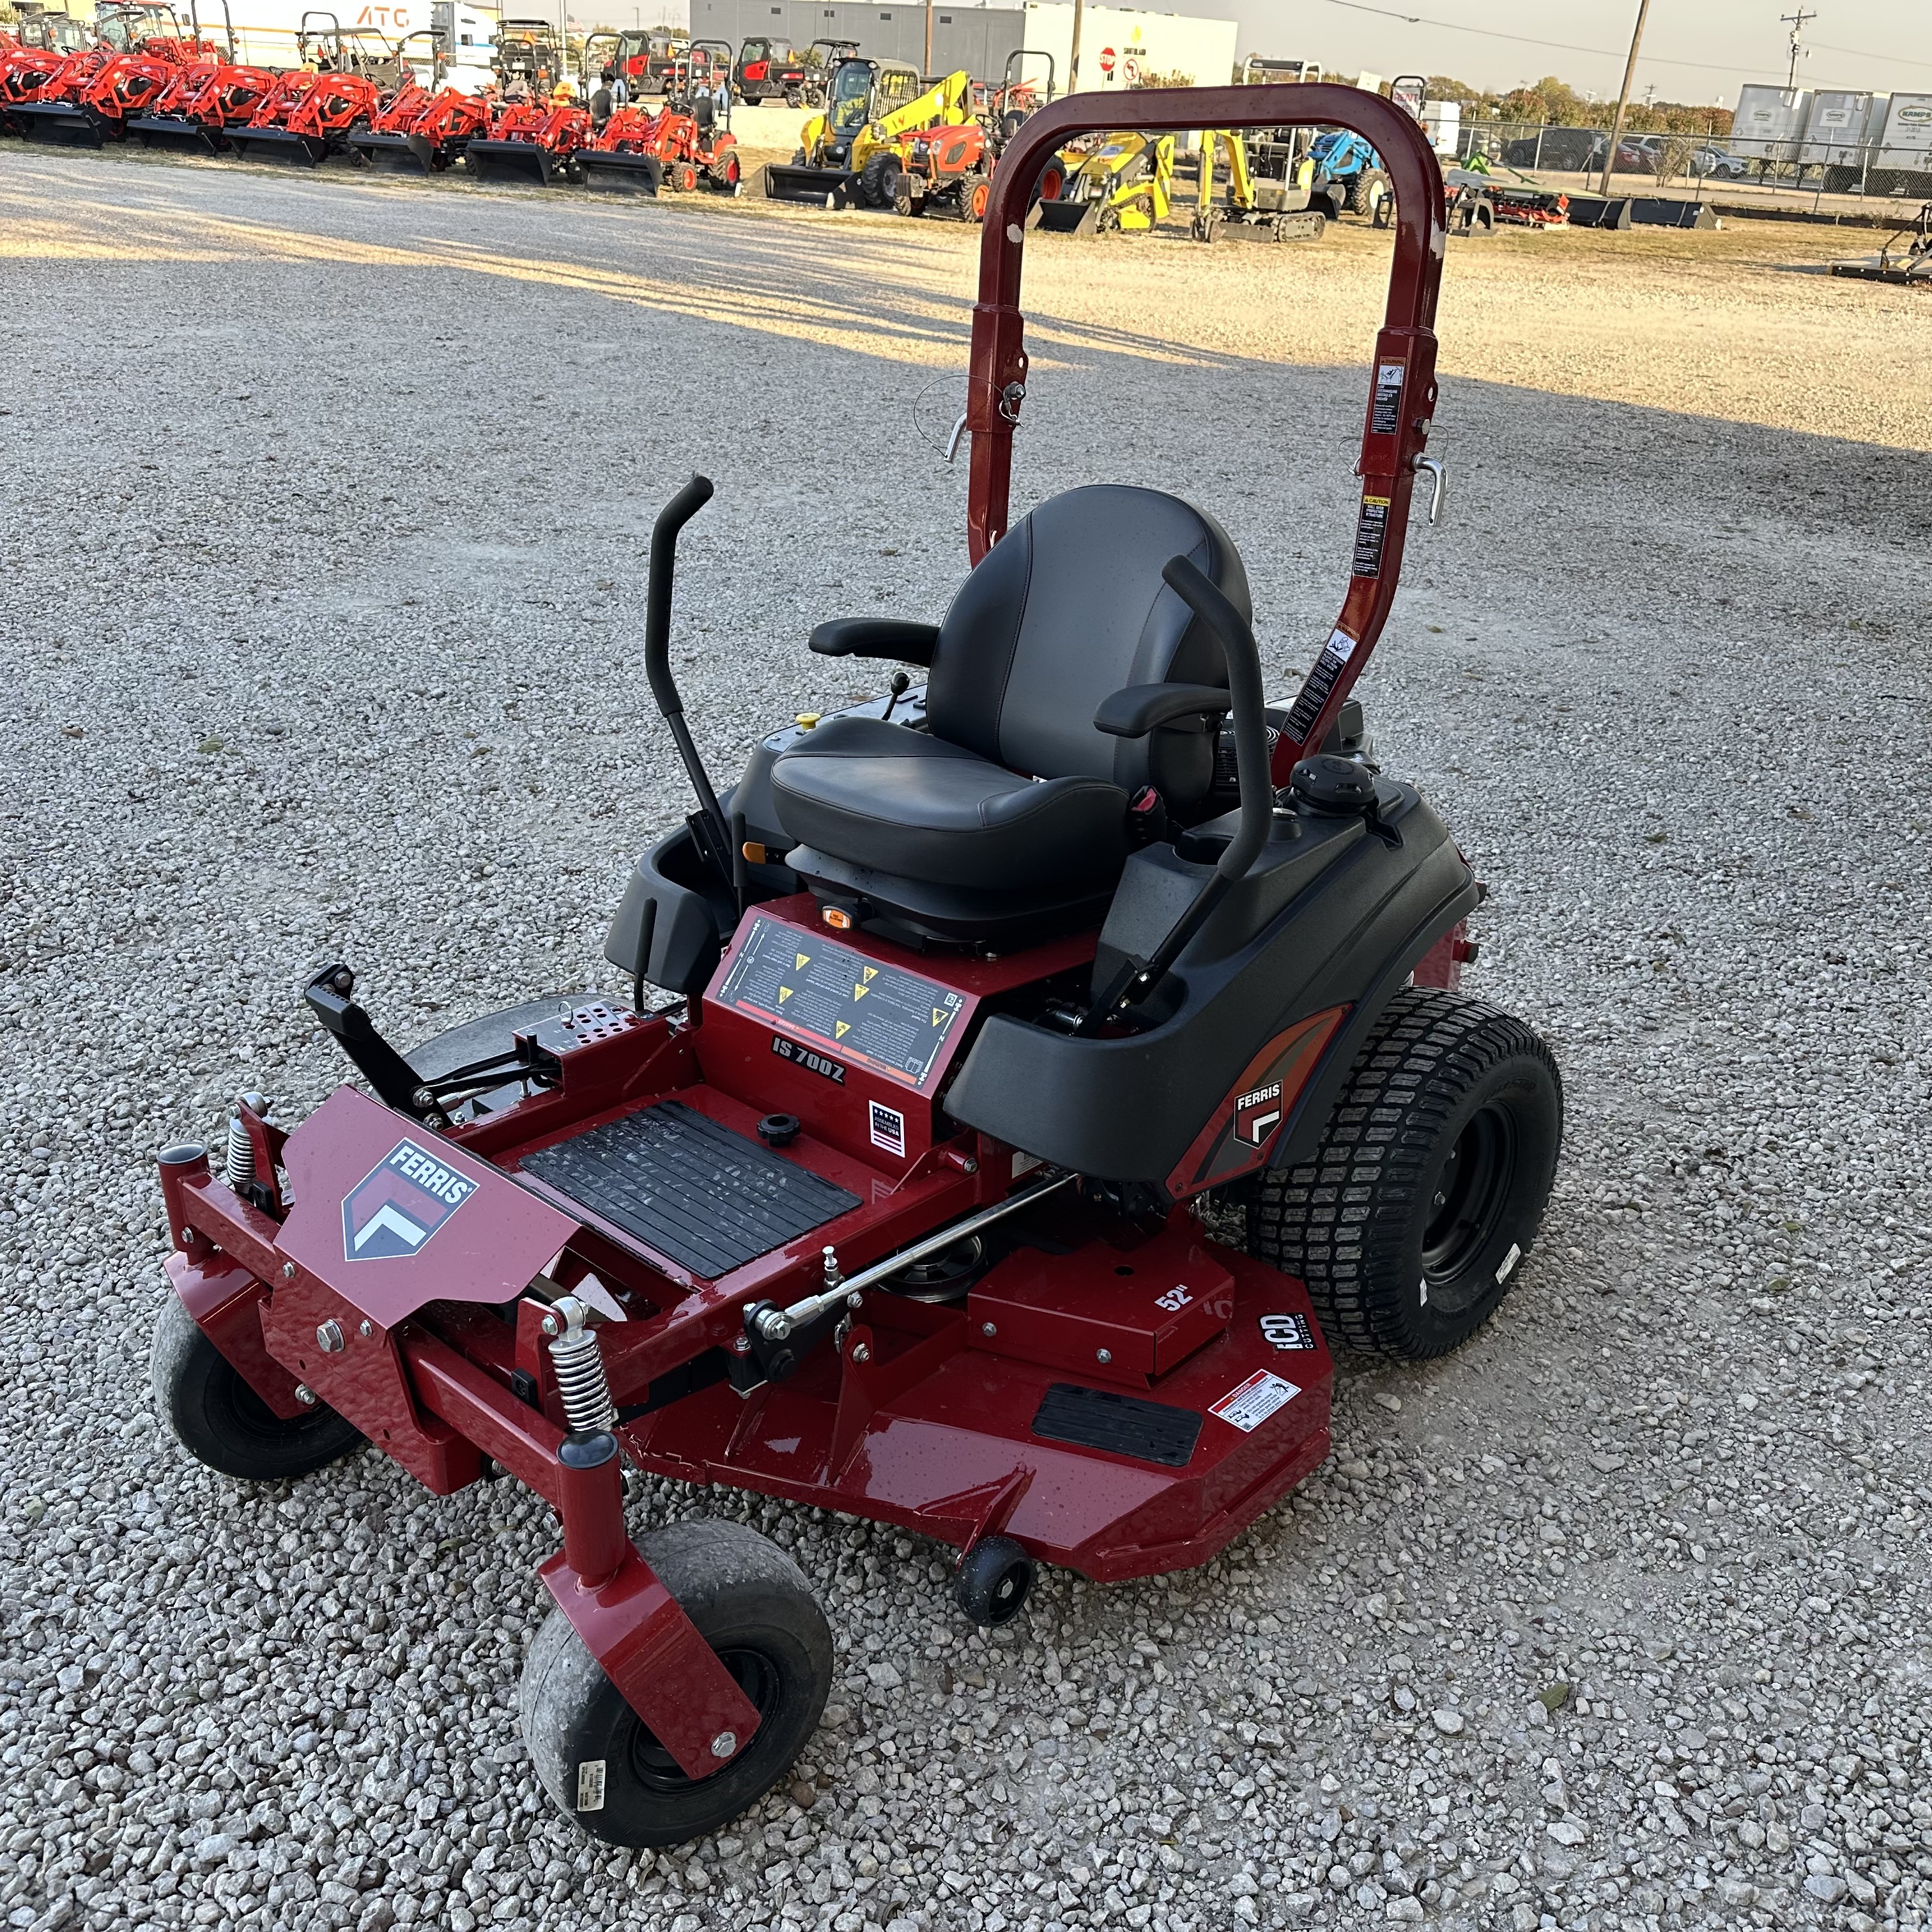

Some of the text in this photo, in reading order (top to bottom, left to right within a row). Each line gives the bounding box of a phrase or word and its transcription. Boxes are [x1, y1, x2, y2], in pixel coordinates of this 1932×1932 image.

[1100, 53, 1116, 65] STOP
[772, 1037, 845, 1083] IS 700Z
[1238, 1084, 1280, 1110] FERRIS
[875, 1116, 900, 1131] ASSEMBLED
[888, 1126, 900, 1136] USA
[389, 1146, 468, 1203] FERRIS
[1154, 1284, 1193, 1311] 52"
[1294, 1314, 1314, 1349] CUTTING
[1230, 1382, 1252, 1398] DANGER
